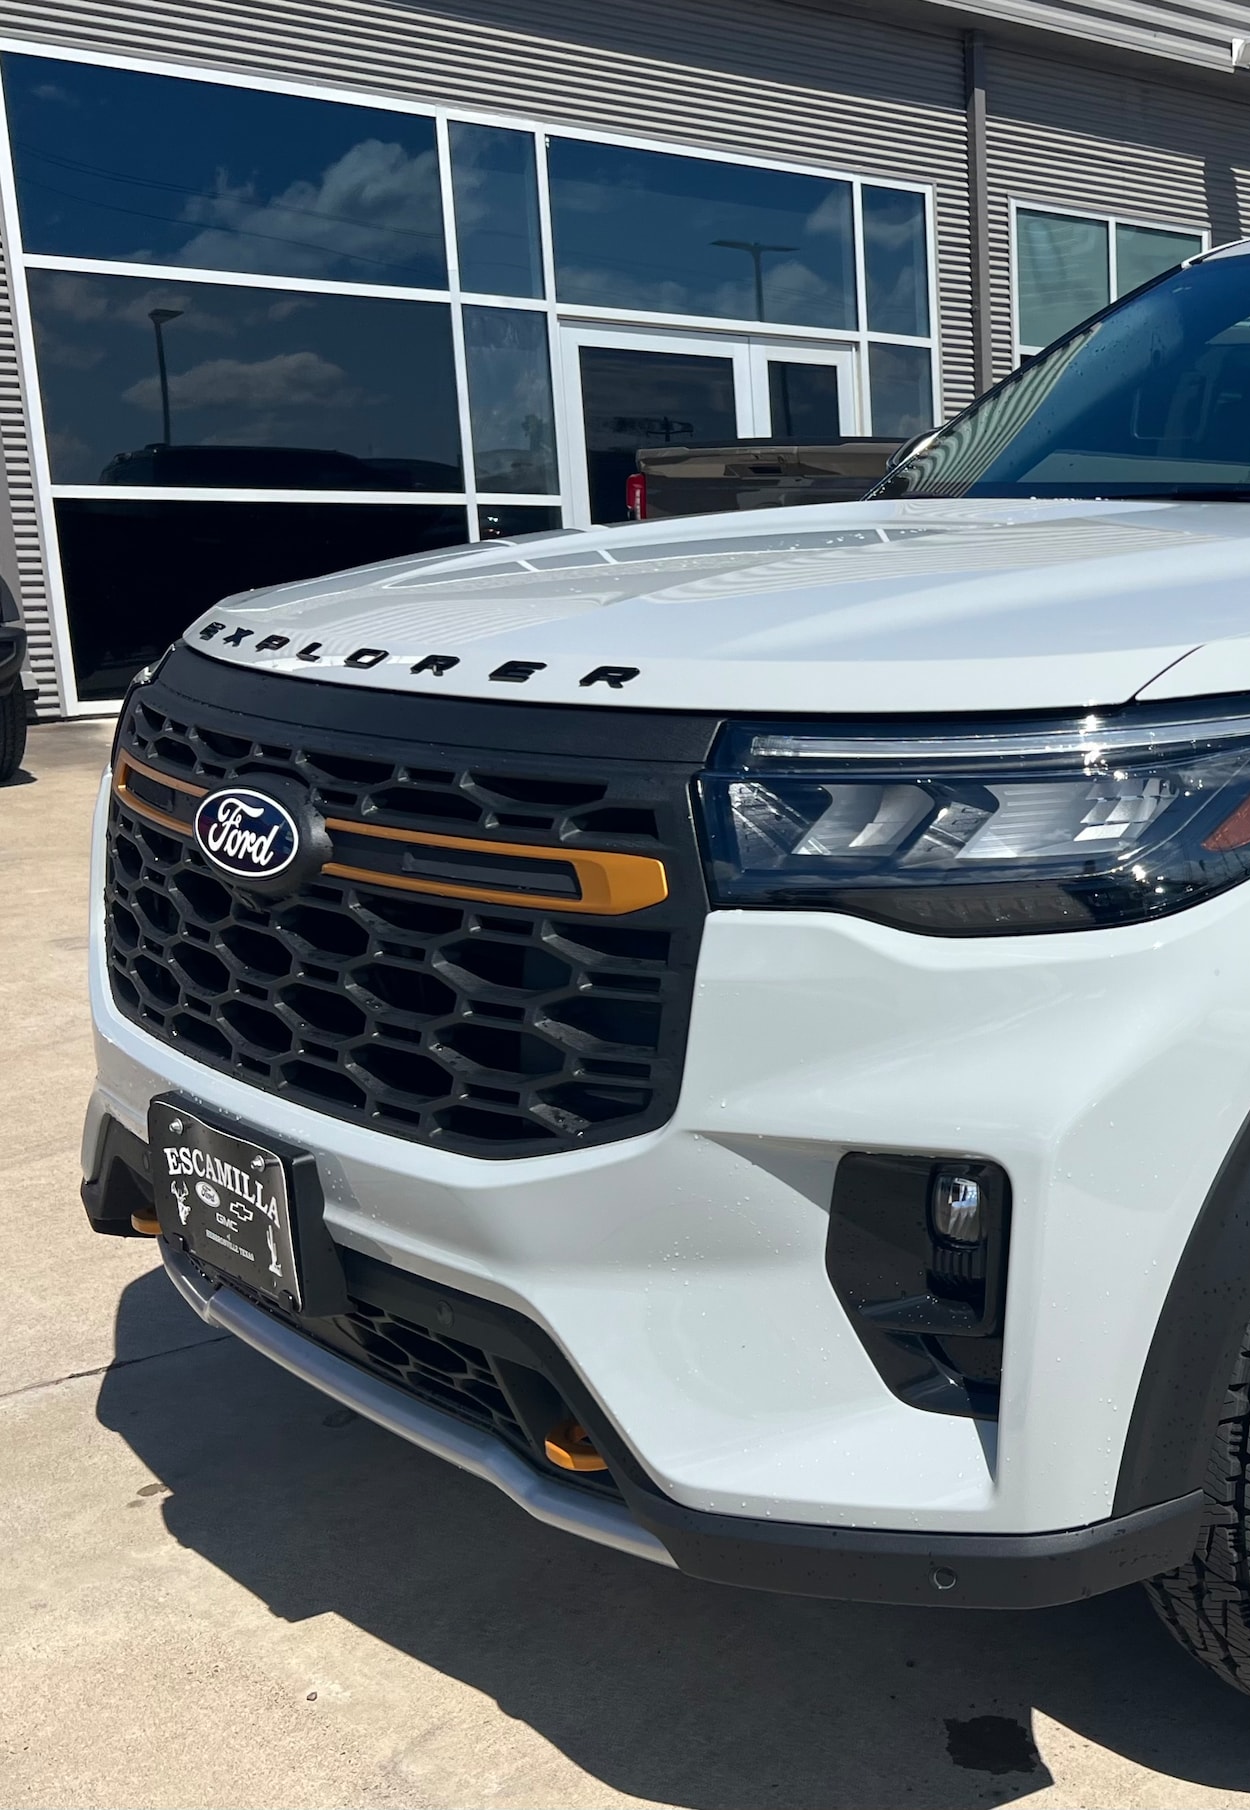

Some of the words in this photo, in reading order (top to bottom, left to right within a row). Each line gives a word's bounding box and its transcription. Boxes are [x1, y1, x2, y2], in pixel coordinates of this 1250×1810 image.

[199, 621, 641, 689] EXPLORER
[206, 795, 277, 868] Ford
[163, 1147, 281, 1229] ESCAMILLA
[215, 1212, 239, 1233] GMC
